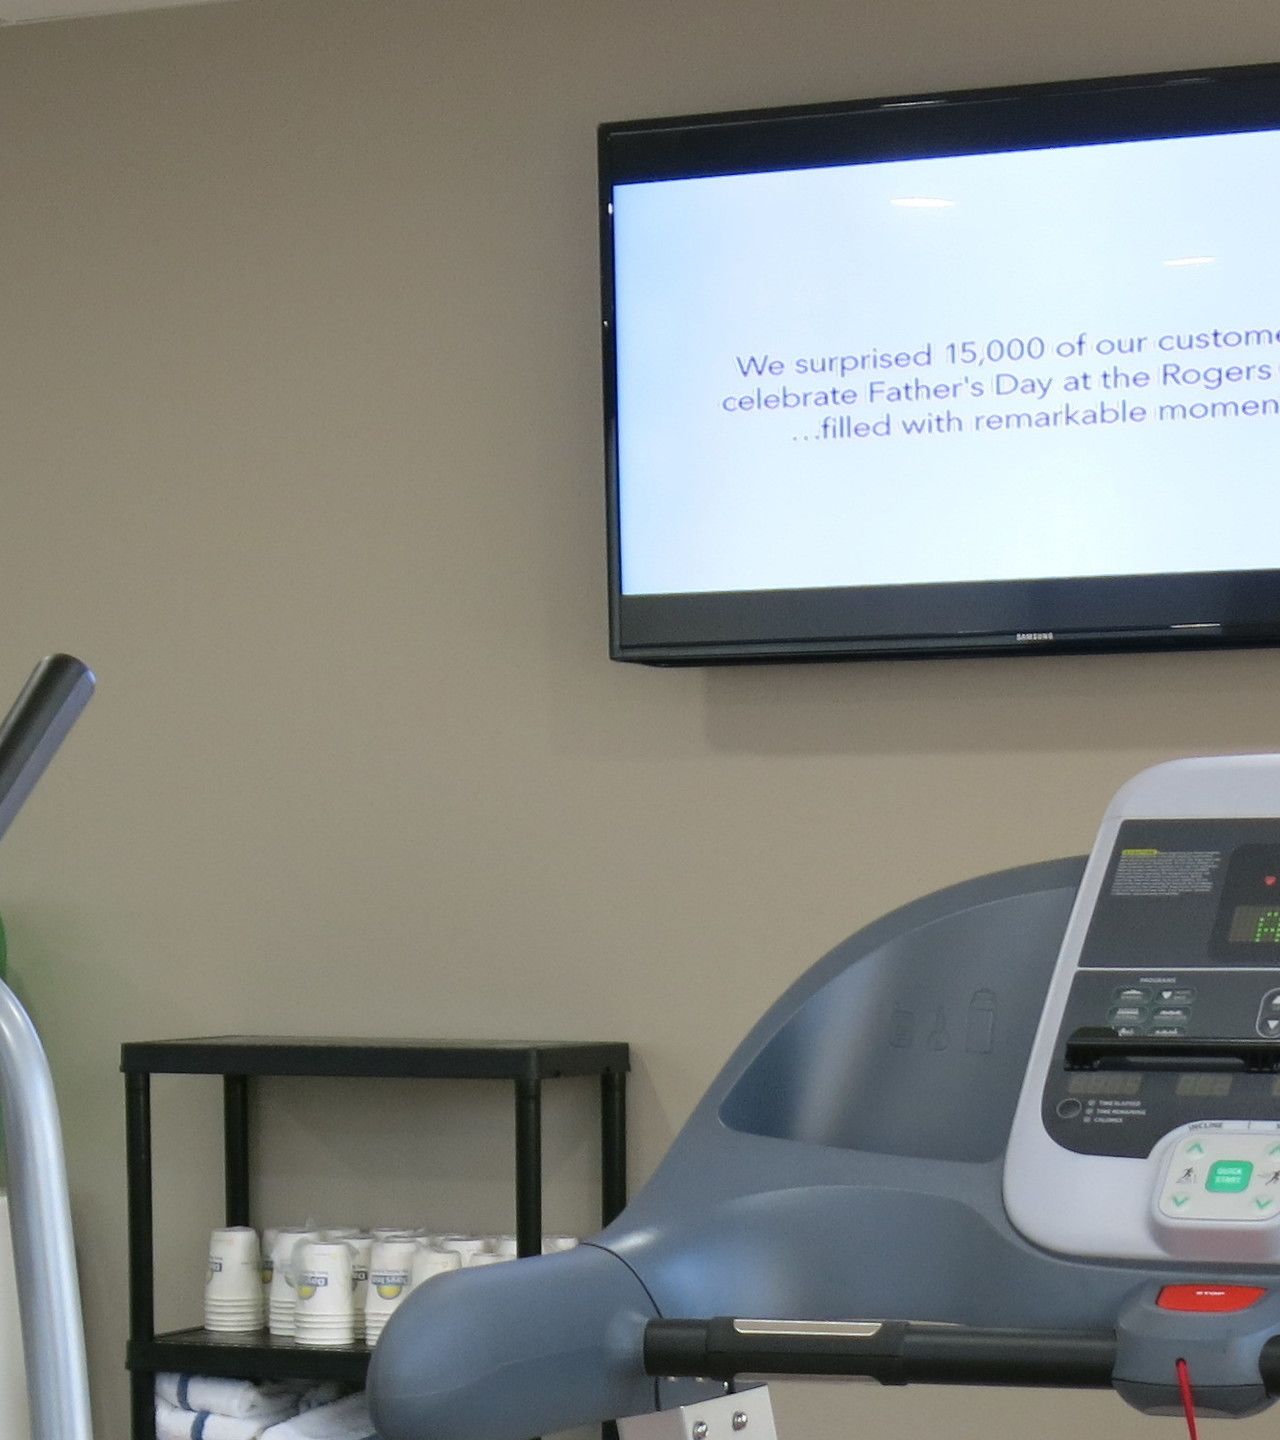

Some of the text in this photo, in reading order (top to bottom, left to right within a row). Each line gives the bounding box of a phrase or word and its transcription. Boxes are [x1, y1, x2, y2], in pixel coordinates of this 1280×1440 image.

[736, 354, 785, 378] We
[795, 343, 932, 378] surprised
[946, 336, 1045, 367] 15,000
[1055, 331, 1087, 358] of
[1096, 337, 1148, 356] our
[722, 386, 858, 413] celebrate
[869, 376, 985, 404] Father's
[995, 373, 1054, 401] Day
[1063, 371, 1092, 392] at
[1101, 366, 1151, 390] the
[1162, 362, 1272, 391] Rogers
[902, 410, 963, 435] with
[975, 400, 1148, 431] remarkable
[1016, 632, 1054, 641] SAMSUNG
